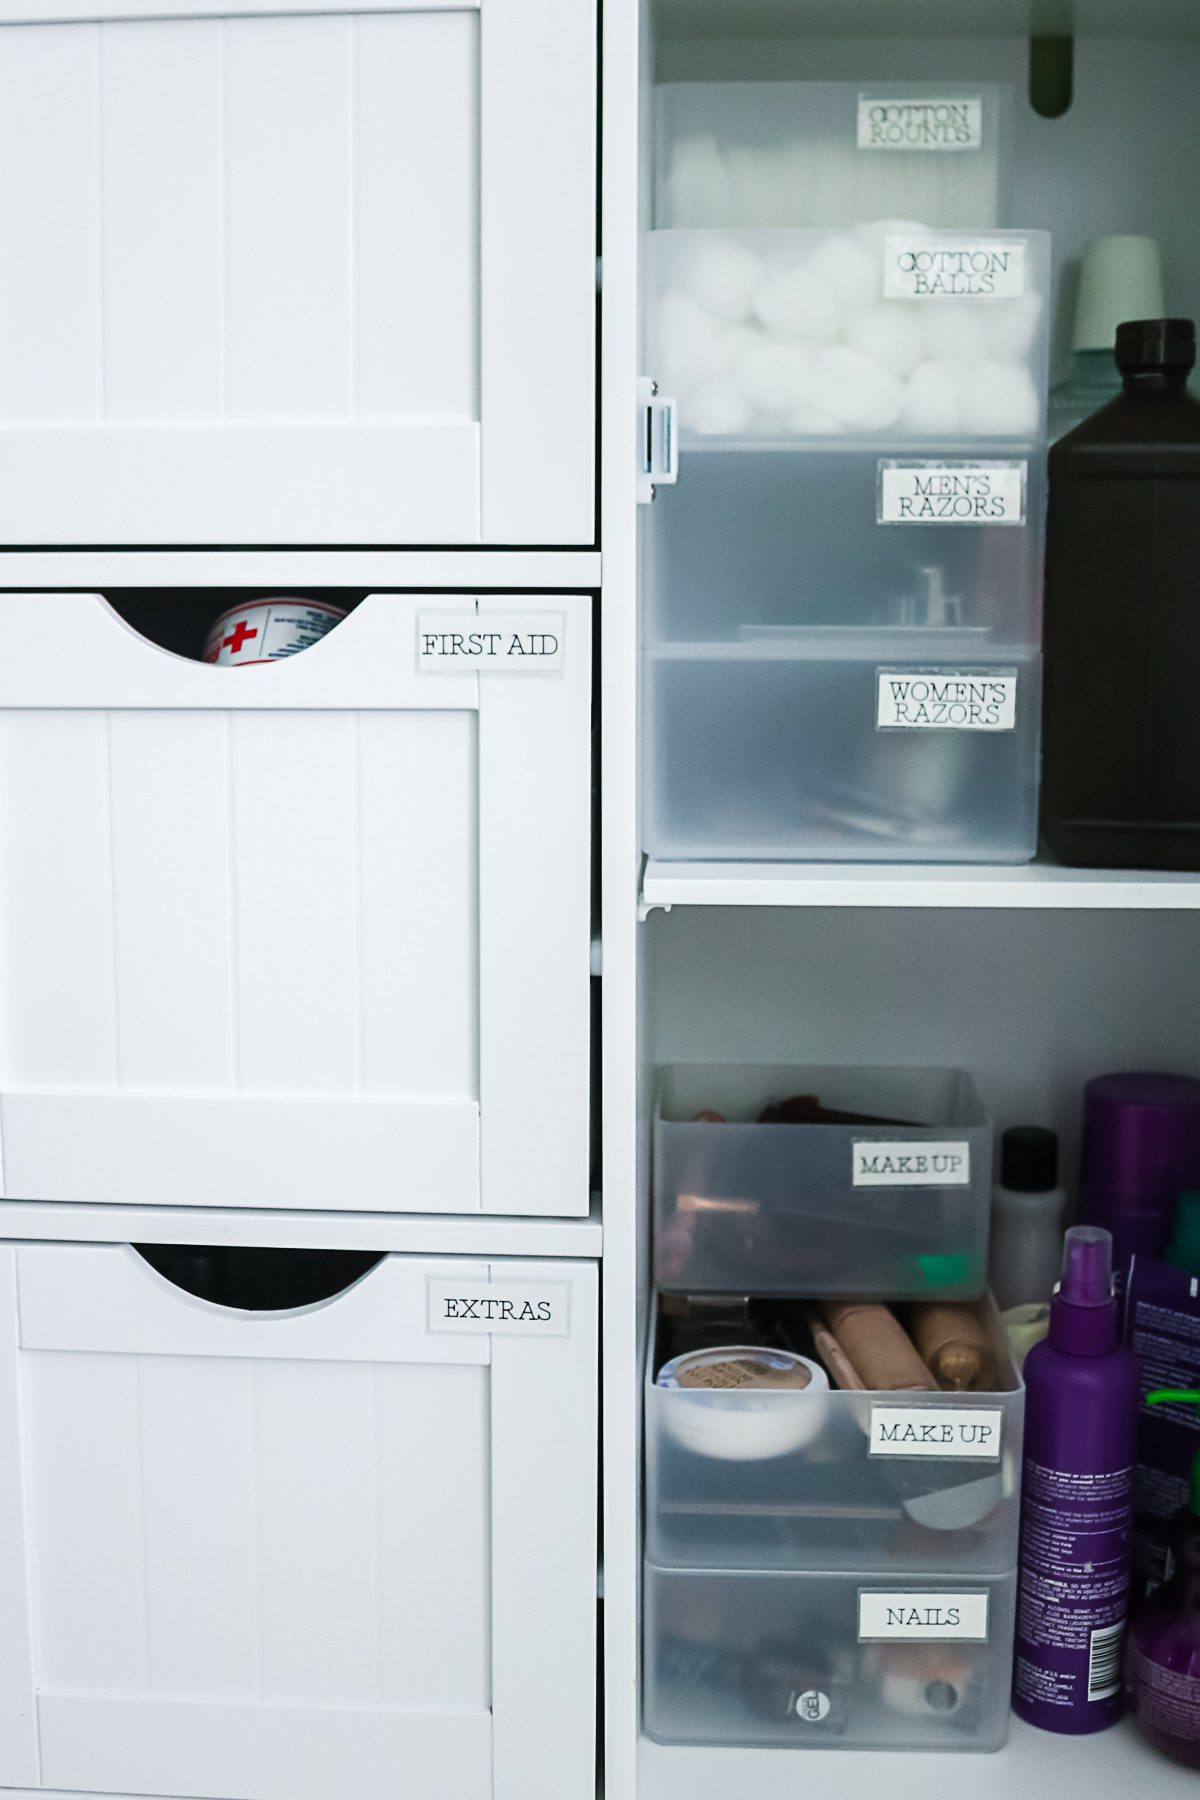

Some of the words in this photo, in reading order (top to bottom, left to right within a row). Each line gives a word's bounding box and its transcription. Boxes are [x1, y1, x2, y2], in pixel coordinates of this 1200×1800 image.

[869, 104, 969, 125] COTTON
[869, 123, 970, 144] ROUNDS
[898, 251, 1010, 273] COTTON
[914, 273, 995, 295] BALLS
[913, 475, 991, 496] MEN'S
[898, 496, 1005, 518] RAZORS
[422, 634, 502, 656] FIRST
[507, 634, 559, 656] AID
[889, 681, 1007, 704] WOMEN'S
[893, 703, 1000, 724] RAZORS
[444, 1298, 551, 1321] EXTRAS
[886, 1608, 961, 1626] NAILS
